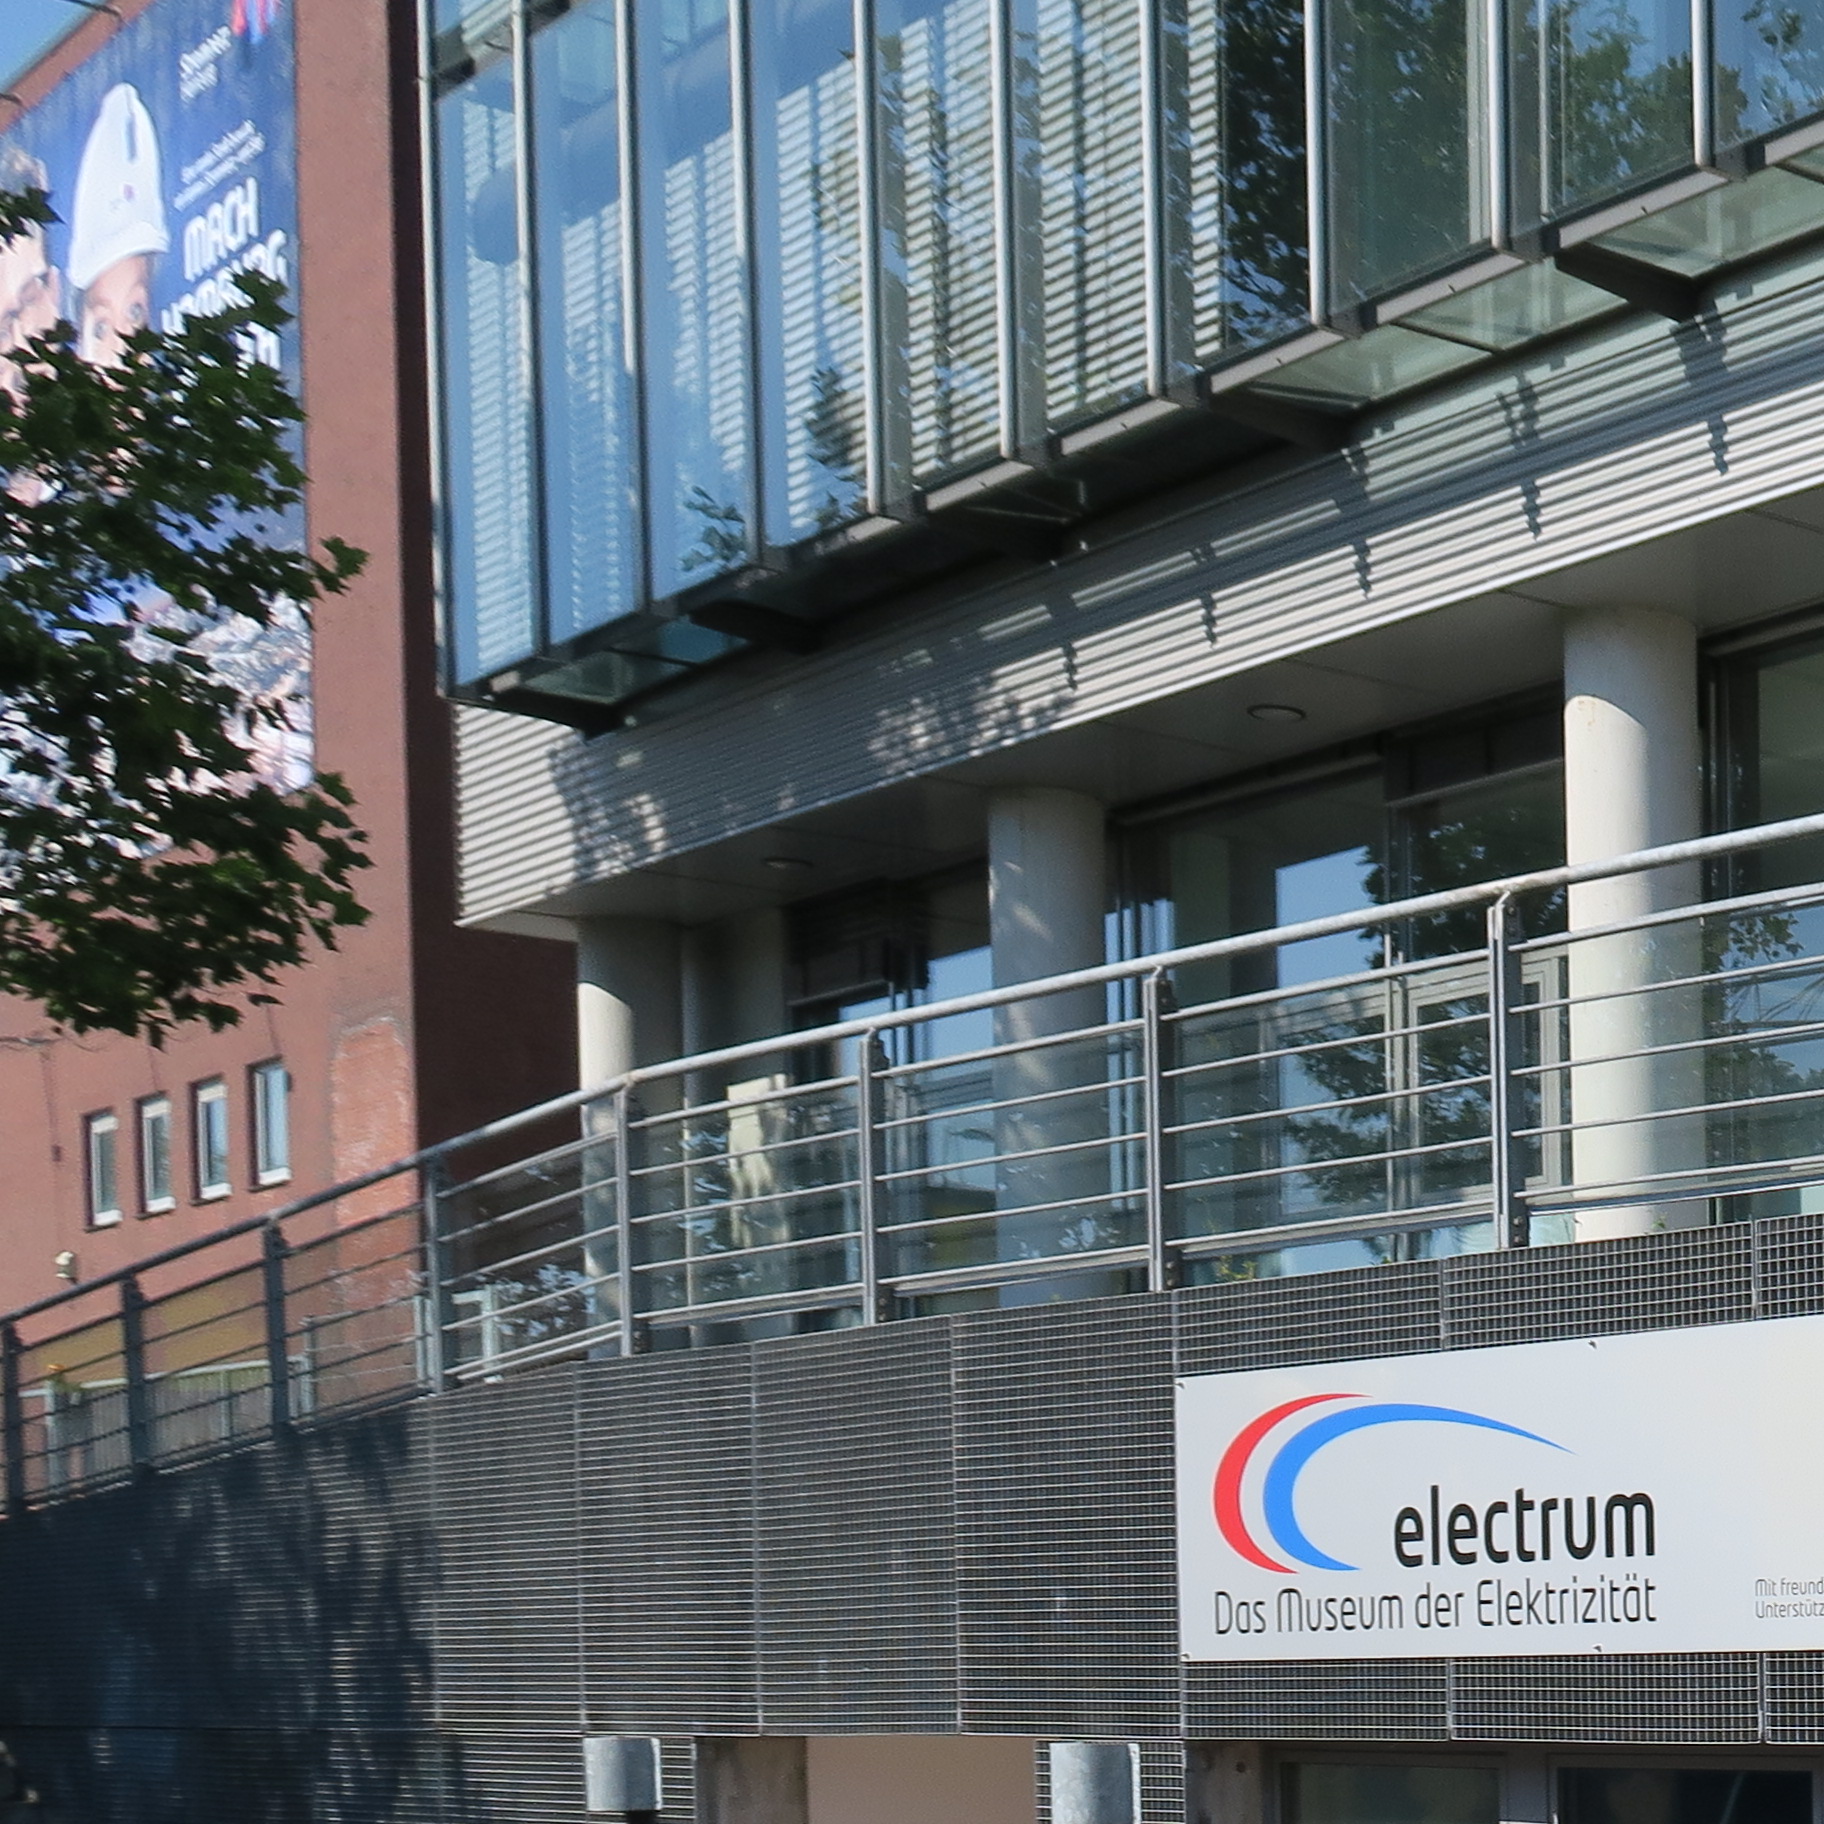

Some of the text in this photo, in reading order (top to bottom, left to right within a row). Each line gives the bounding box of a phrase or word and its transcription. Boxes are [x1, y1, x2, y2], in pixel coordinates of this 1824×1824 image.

[184, 176, 259, 282] MACH
[1393, 1484, 1656, 1568] electrum
[1214, 1573, 1657, 1635] Das Museum der Elektrizität
[1755, 1578, 1777, 1597] Mit
